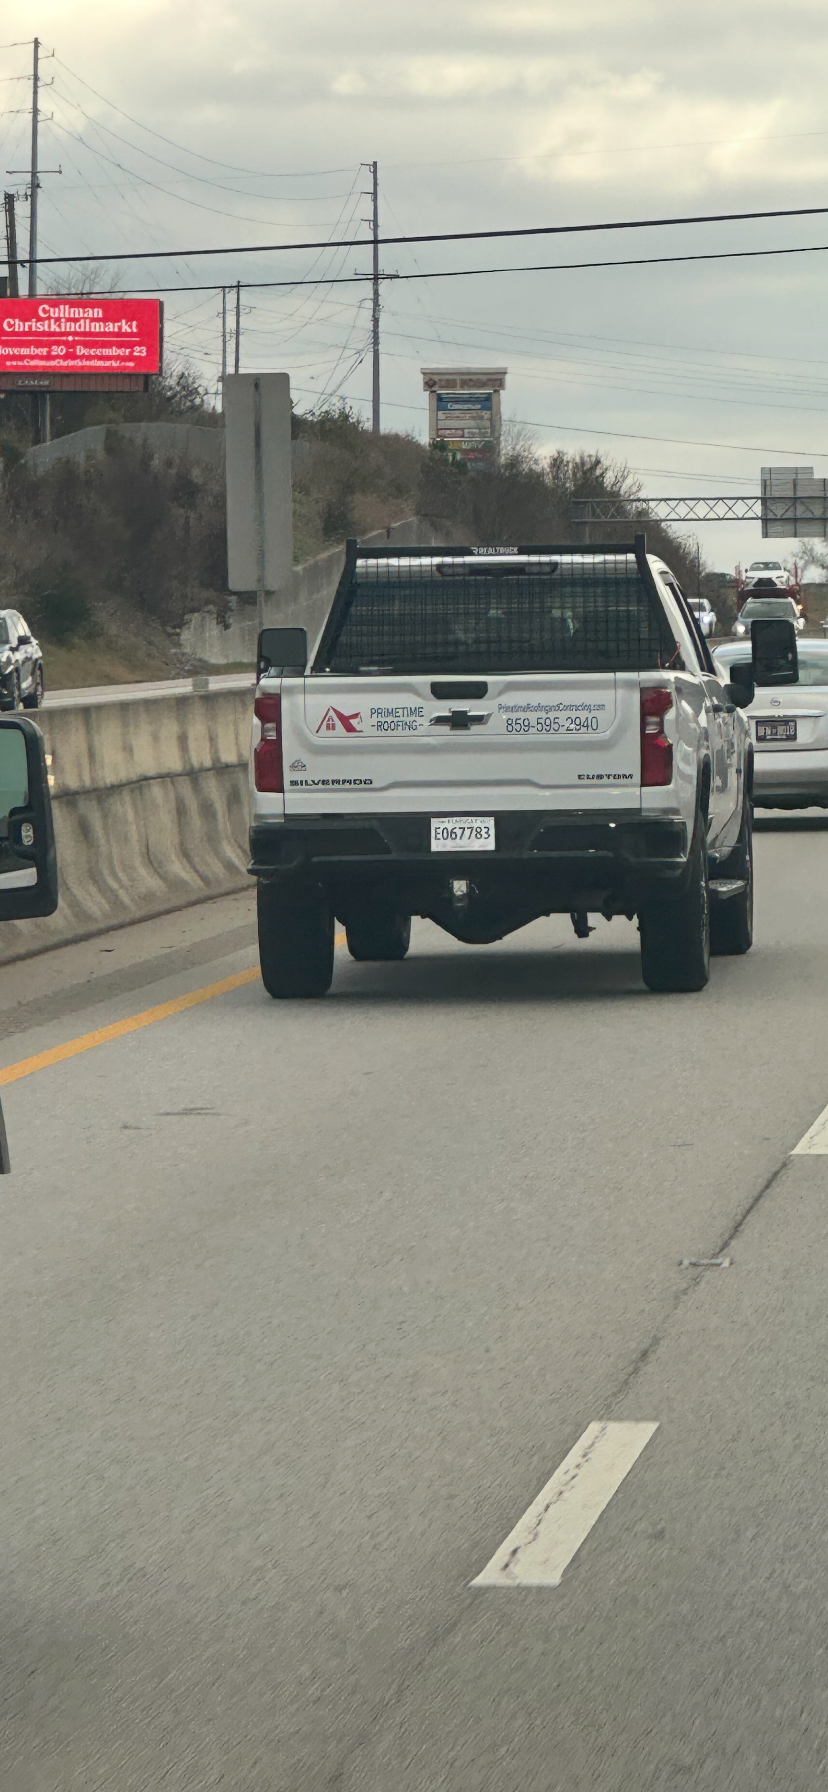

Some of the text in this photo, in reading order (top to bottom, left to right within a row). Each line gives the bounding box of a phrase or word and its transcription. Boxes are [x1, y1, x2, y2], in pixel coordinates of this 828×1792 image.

[38, 304, 103, 318] Cullman
[3, 318, 137, 333] Christkindlmarkt
[51, 345, 66, 356] 20
[76, 345, 130, 356] December
[133, 346, 147, 357] 23
[506, 716, 599, 733] 859-595-2940
[434, 826, 491, 841] E067783
